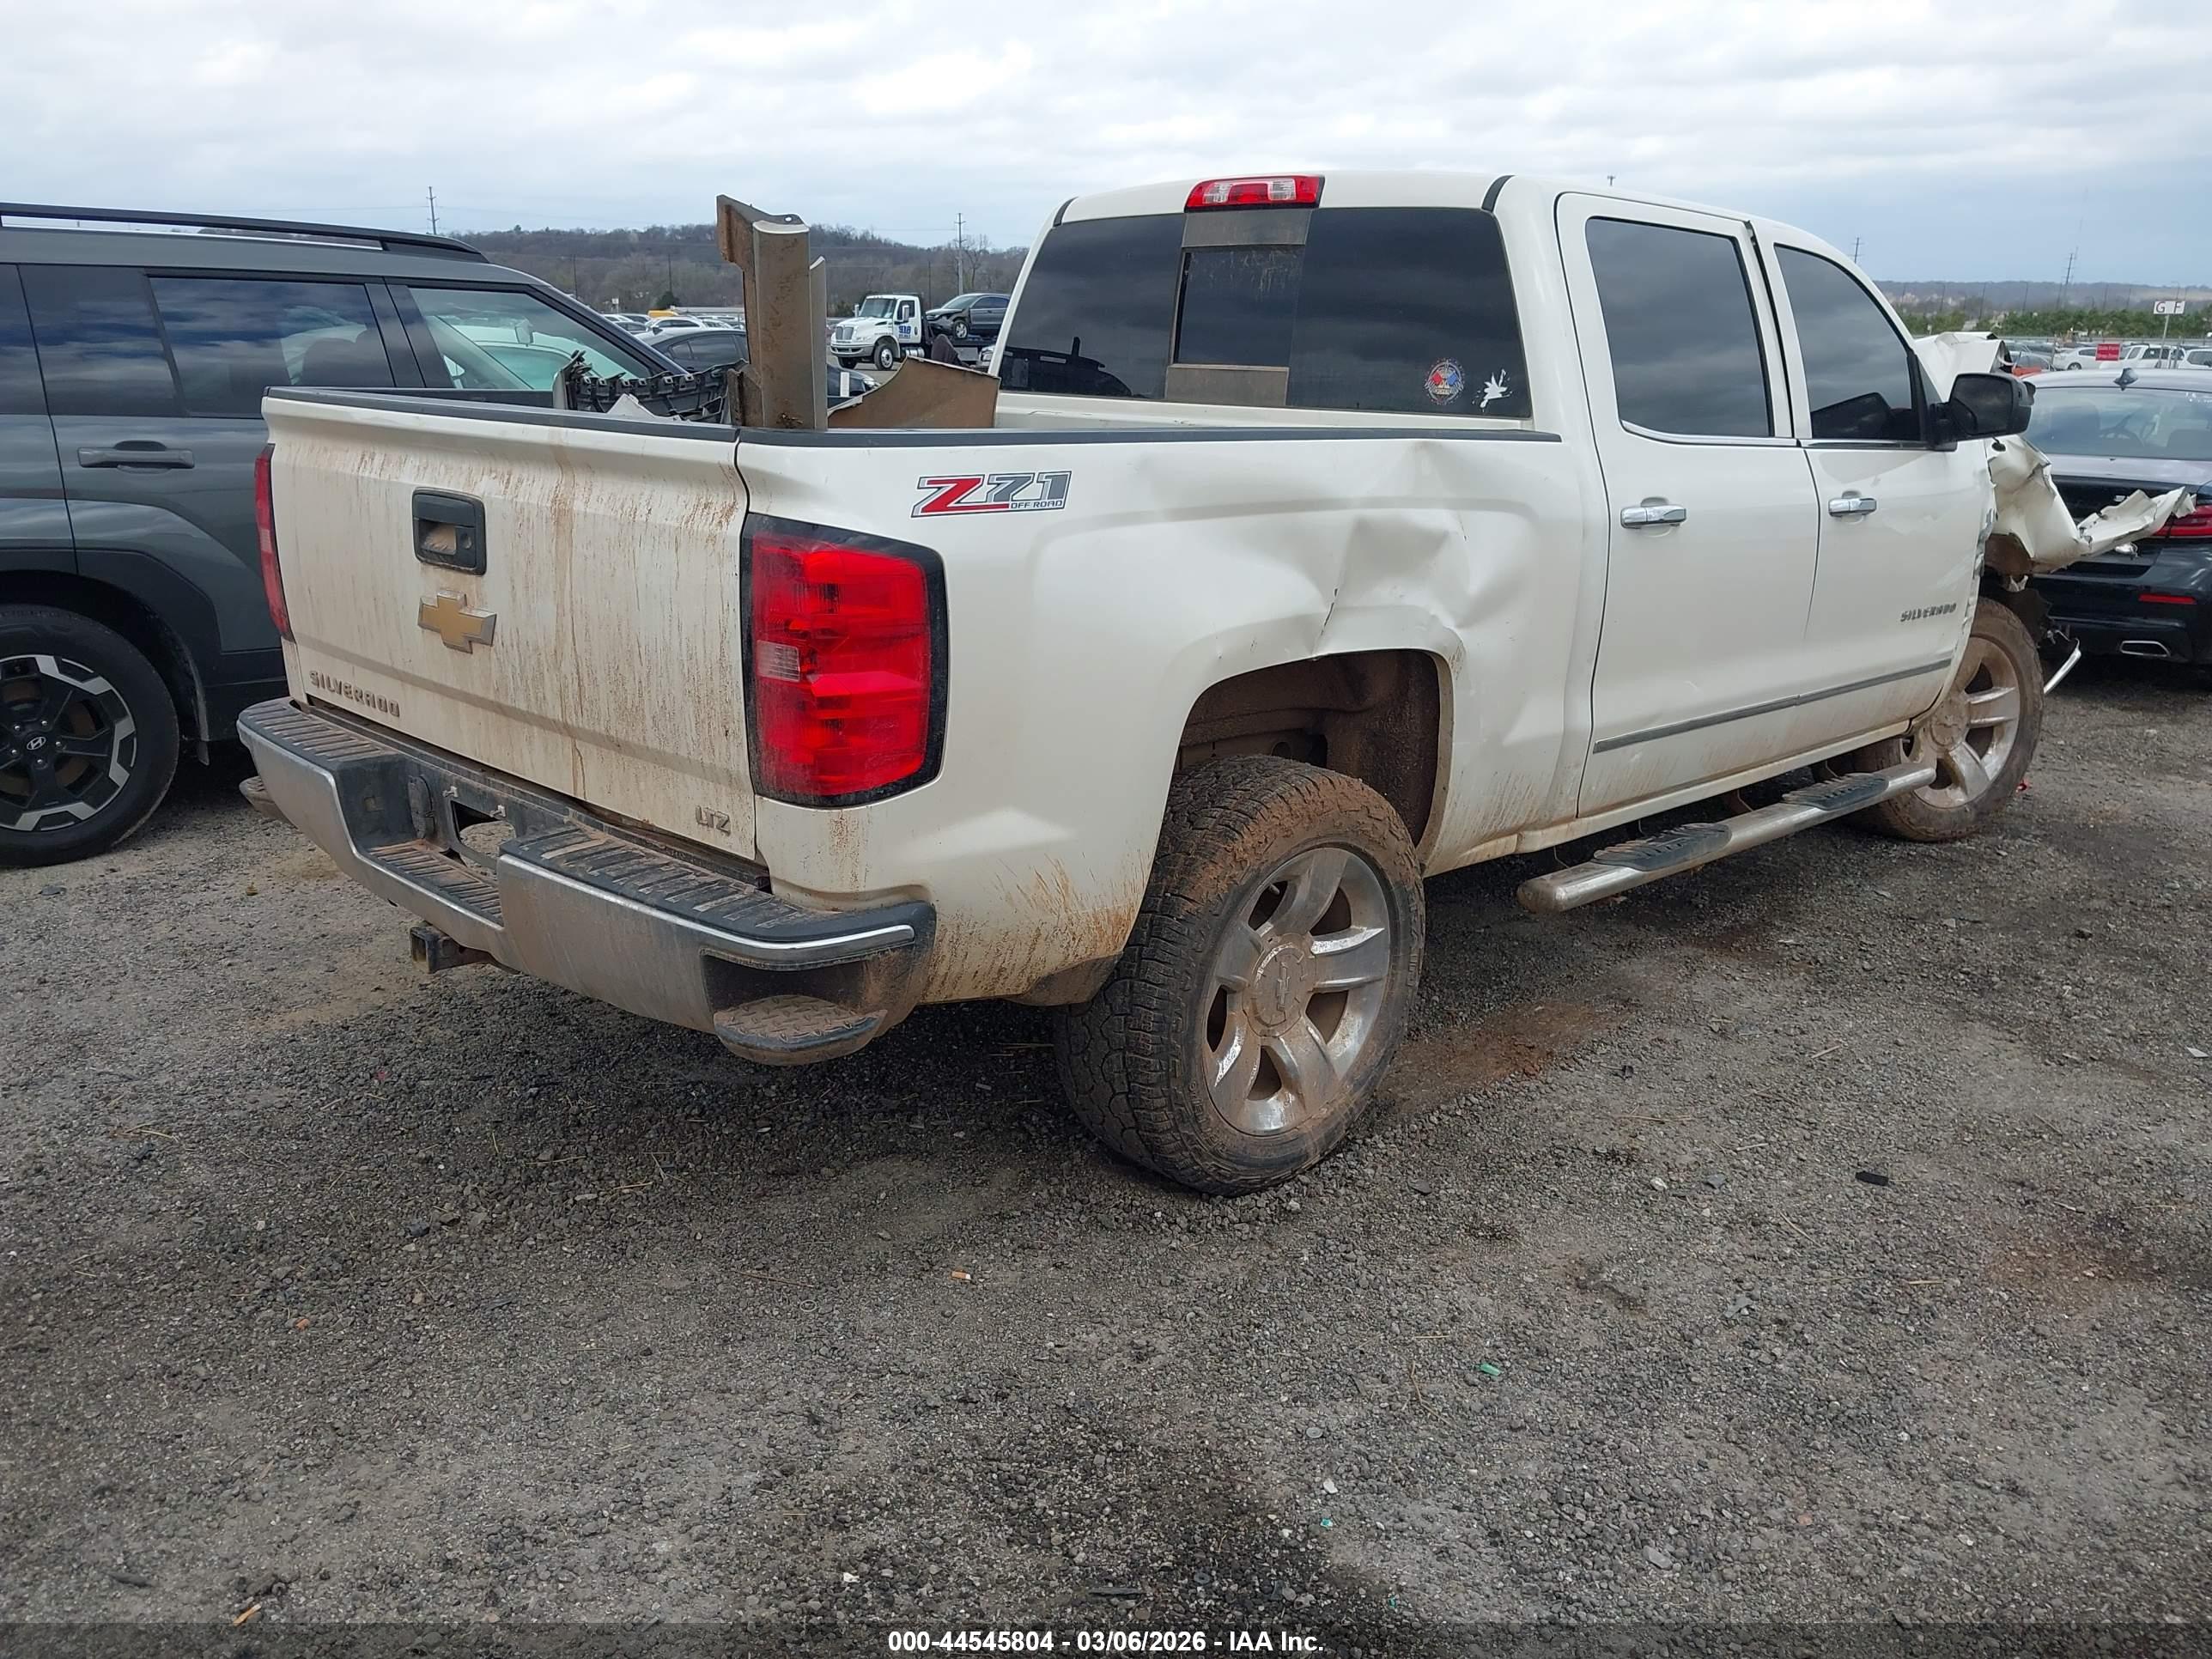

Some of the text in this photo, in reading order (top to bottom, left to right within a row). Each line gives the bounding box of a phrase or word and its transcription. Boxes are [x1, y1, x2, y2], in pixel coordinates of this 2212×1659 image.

[2156, 301, 2183, 313] G F
[911, 471, 1072, 517] Z71
[1900, 603, 1957, 622] SILVERADO
[309, 670, 400, 718] SILVERADO
[696, 805, 732, 836] LTZ
